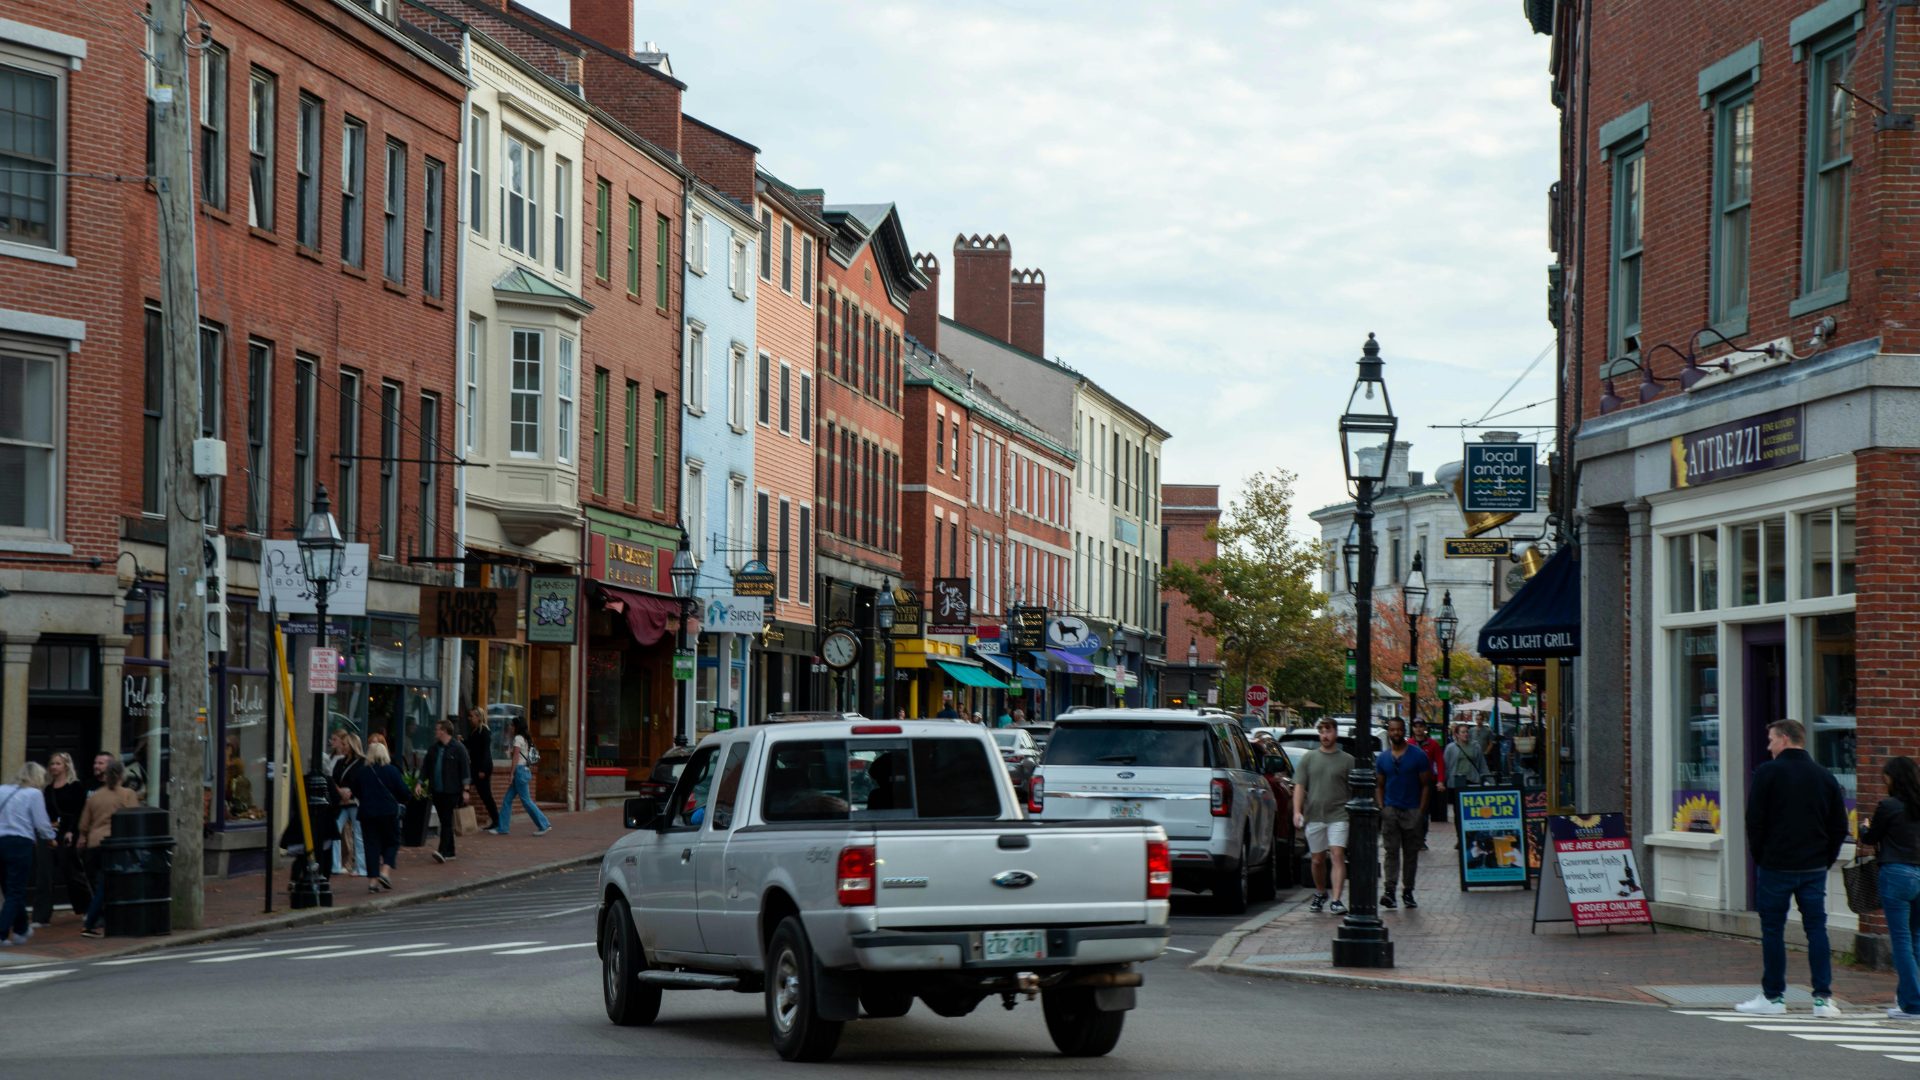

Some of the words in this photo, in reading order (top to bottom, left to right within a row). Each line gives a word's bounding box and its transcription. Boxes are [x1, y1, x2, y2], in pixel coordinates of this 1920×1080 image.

[1775, 417, 1796, 429] KITCHEN
[1763, 431, 1794, 446] ACCESSORIES
[1482, 448, 1518, 462] local
[1688, 425, 1762, 476] ATTREZZI
[1763, 450, 1774, 460] AND
[1473, 462, 1527, 475] anchor
[533, 579, 574, 591] GANESH
[437, 590, 498, 610] FLOWER
[436, 609, 497, 635] KIOSK
[730, 611, 761, 622] SIREN
[982, 643, 999, 651] RSG
[1487, 635, 1510, 650] GAS
[1512, 634, 1542, 650] LIGHT
[1544, 632, 1574, 648] GRILL
[124, 674, 167, 708] Prelude
[1246, 691, 1268, 701] STOP
[230, 684, 264, 715] Prelude
[128, 707, 163, 717] BOUTIQUE
[1463, 794, 1518, 807] HAPPY
[1560, 842, 1575, 851] WE
[1575, 841, 1594, 850] ARE
[1595, 840, 1625, 849] OPEN!!
[1564, 871, 1589, 882] wines,
[1588, 868, 1604, 880] beer
[1567, 887, 1576, 895] &
[1577, 883, 1602, 895] cheese!
[1577, 903, 1608, 912] ORDER
[1609, 901, 1642, 911] ONLINE
[1577, 910, 1646, 919] www.AttrezziNH.com
